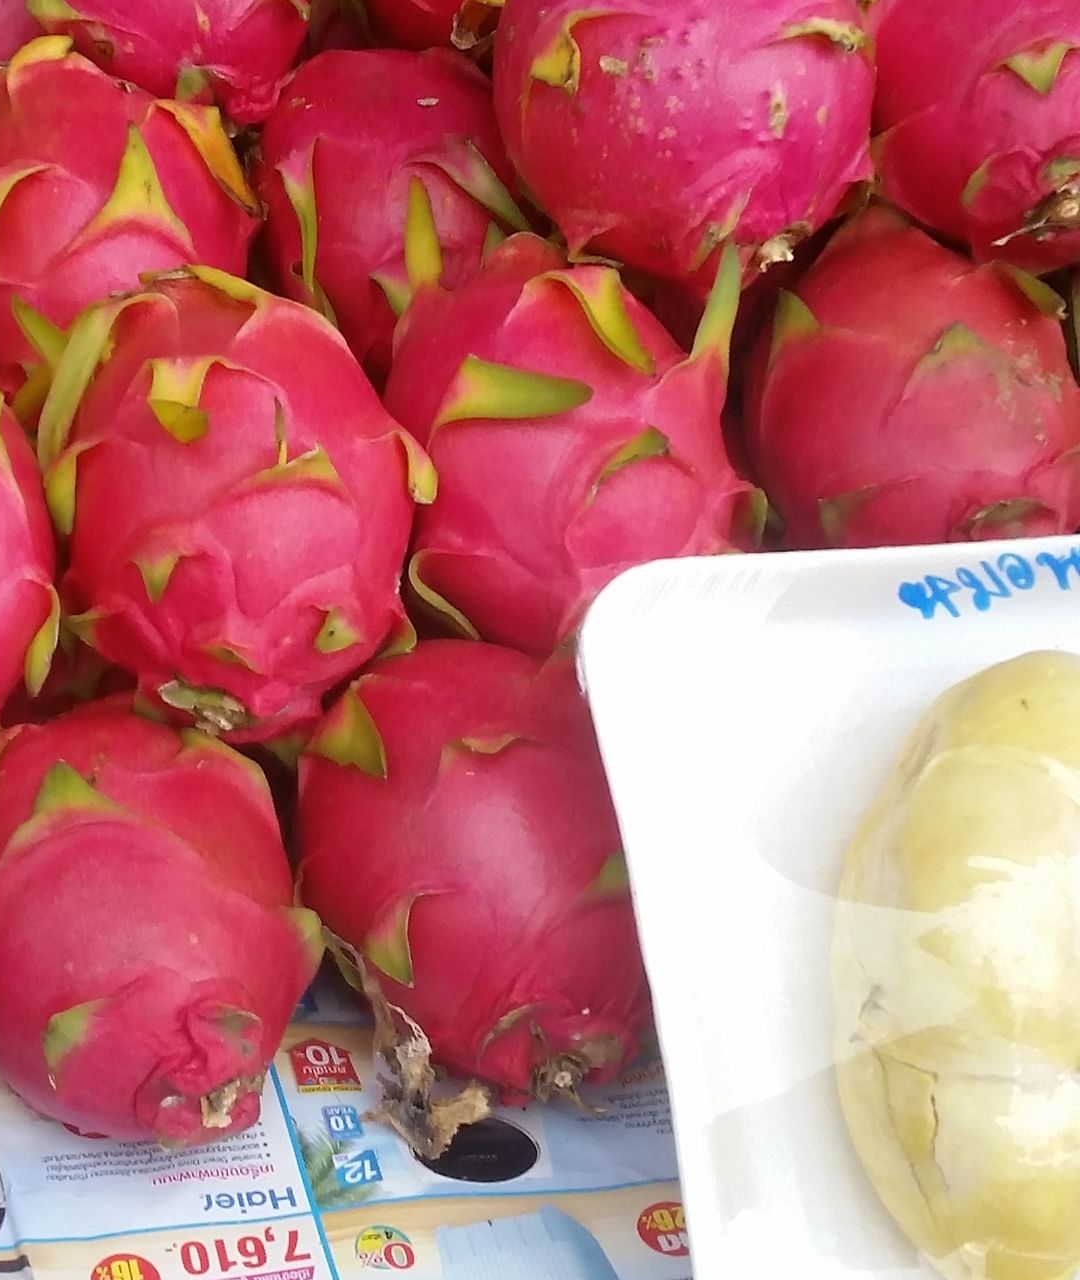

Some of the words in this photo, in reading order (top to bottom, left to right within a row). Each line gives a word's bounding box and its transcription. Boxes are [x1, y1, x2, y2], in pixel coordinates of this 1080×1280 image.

[329, 1114, 355, 1132] 10
[343, 1159, 378, 1185] 12
[203, 1187, 297, 1213] Haier
[164, 1226, 313, 1276] 7,610.-
